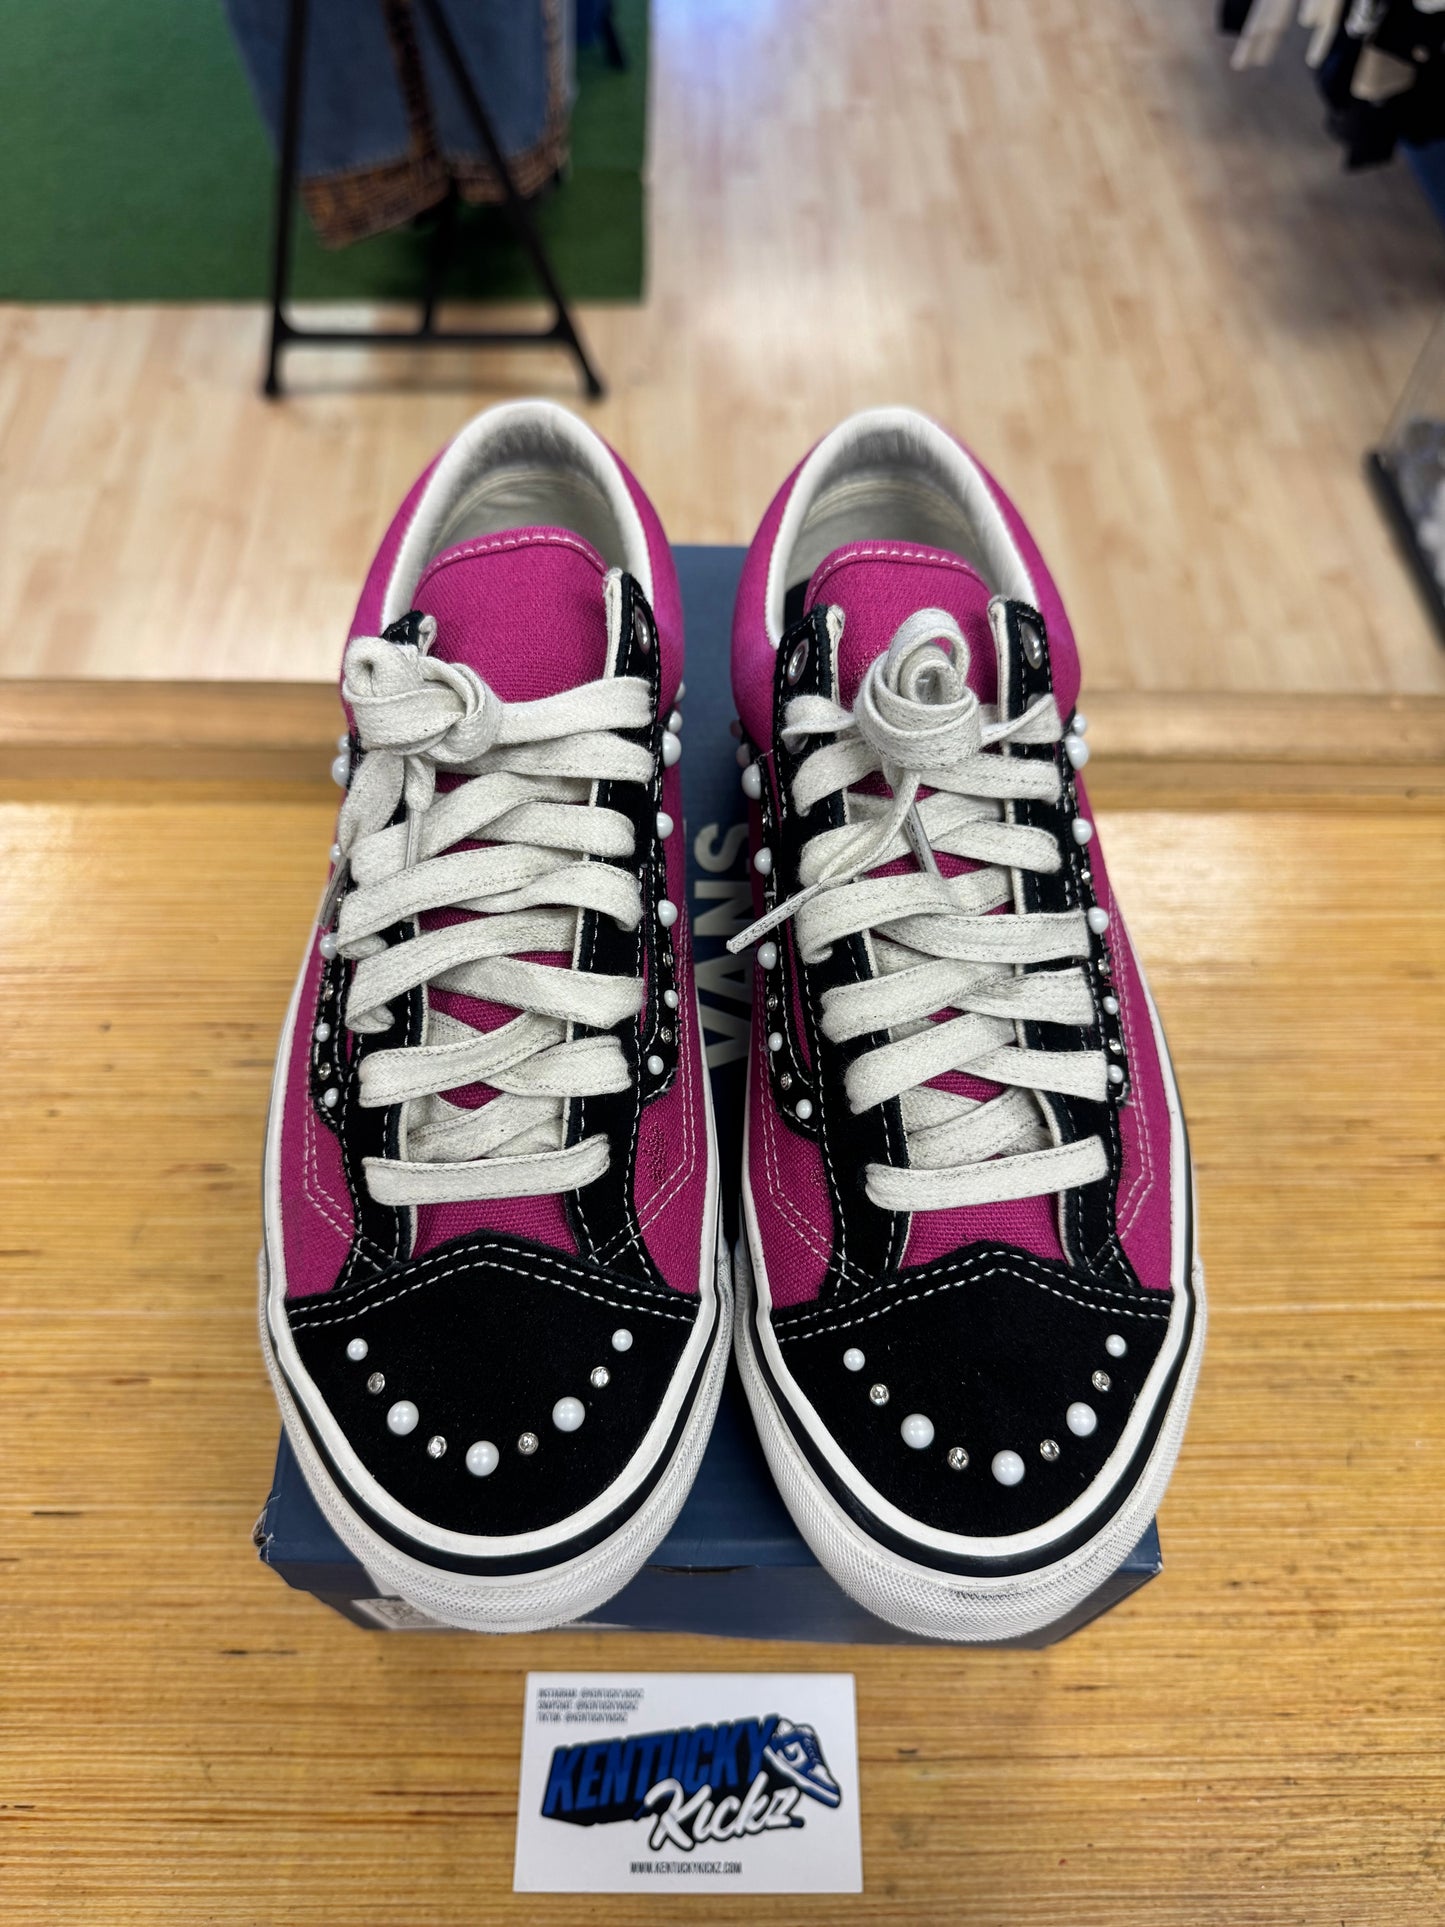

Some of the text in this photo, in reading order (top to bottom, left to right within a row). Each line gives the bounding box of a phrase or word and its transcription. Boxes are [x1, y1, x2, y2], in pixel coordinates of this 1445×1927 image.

[694, 823, 752, 1068] VANS
[543, 1714, 780, 1817] KENTUCKY
[644, 1771, 802, 1850] Kickz
